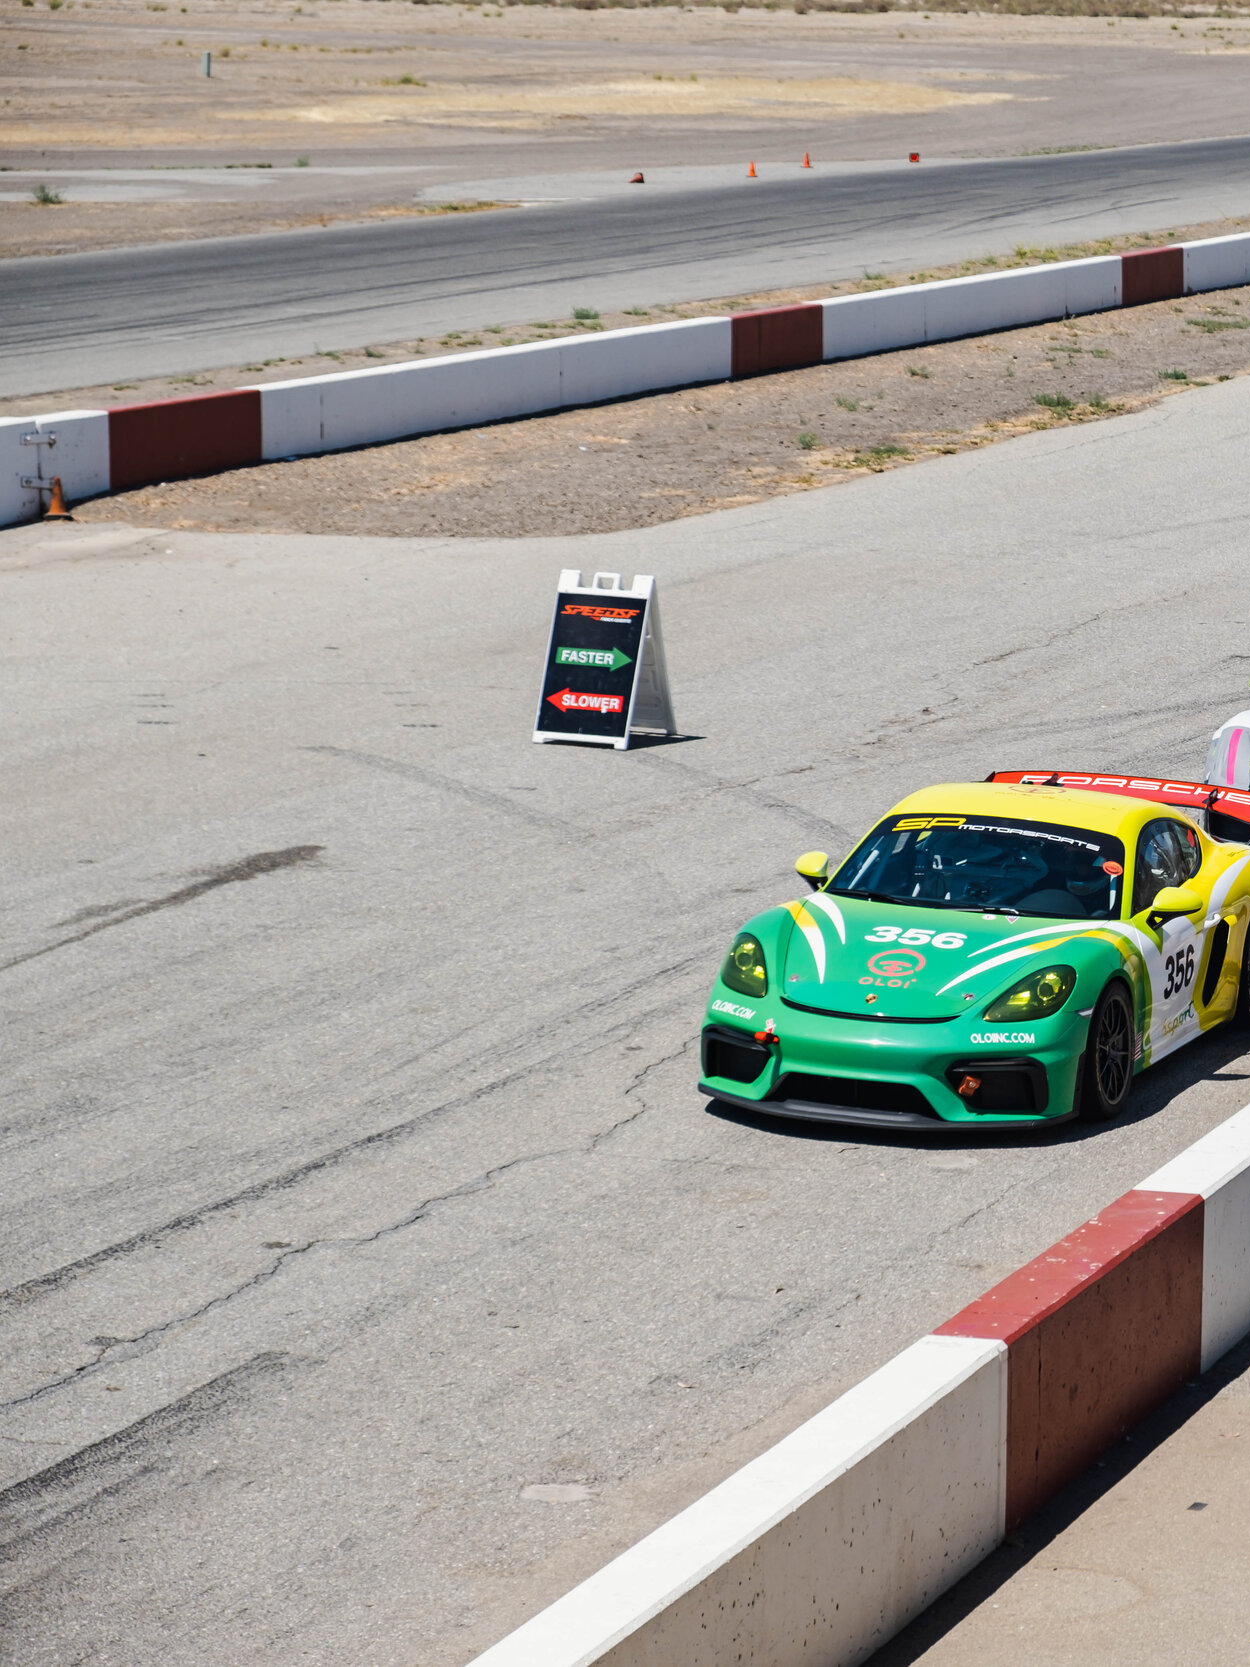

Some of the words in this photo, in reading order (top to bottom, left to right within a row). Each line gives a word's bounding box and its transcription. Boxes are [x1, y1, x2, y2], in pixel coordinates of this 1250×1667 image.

[561, 649, 615, 665] FASTER
[561, 694, 620, 710] SLOWER
[892, 817, 967, 831] SP
[958, 824, 1101, 851] MOTORSPORTS
[864, 925, 968, 949] 356
[1163, 943, 1195, 1000] 356
